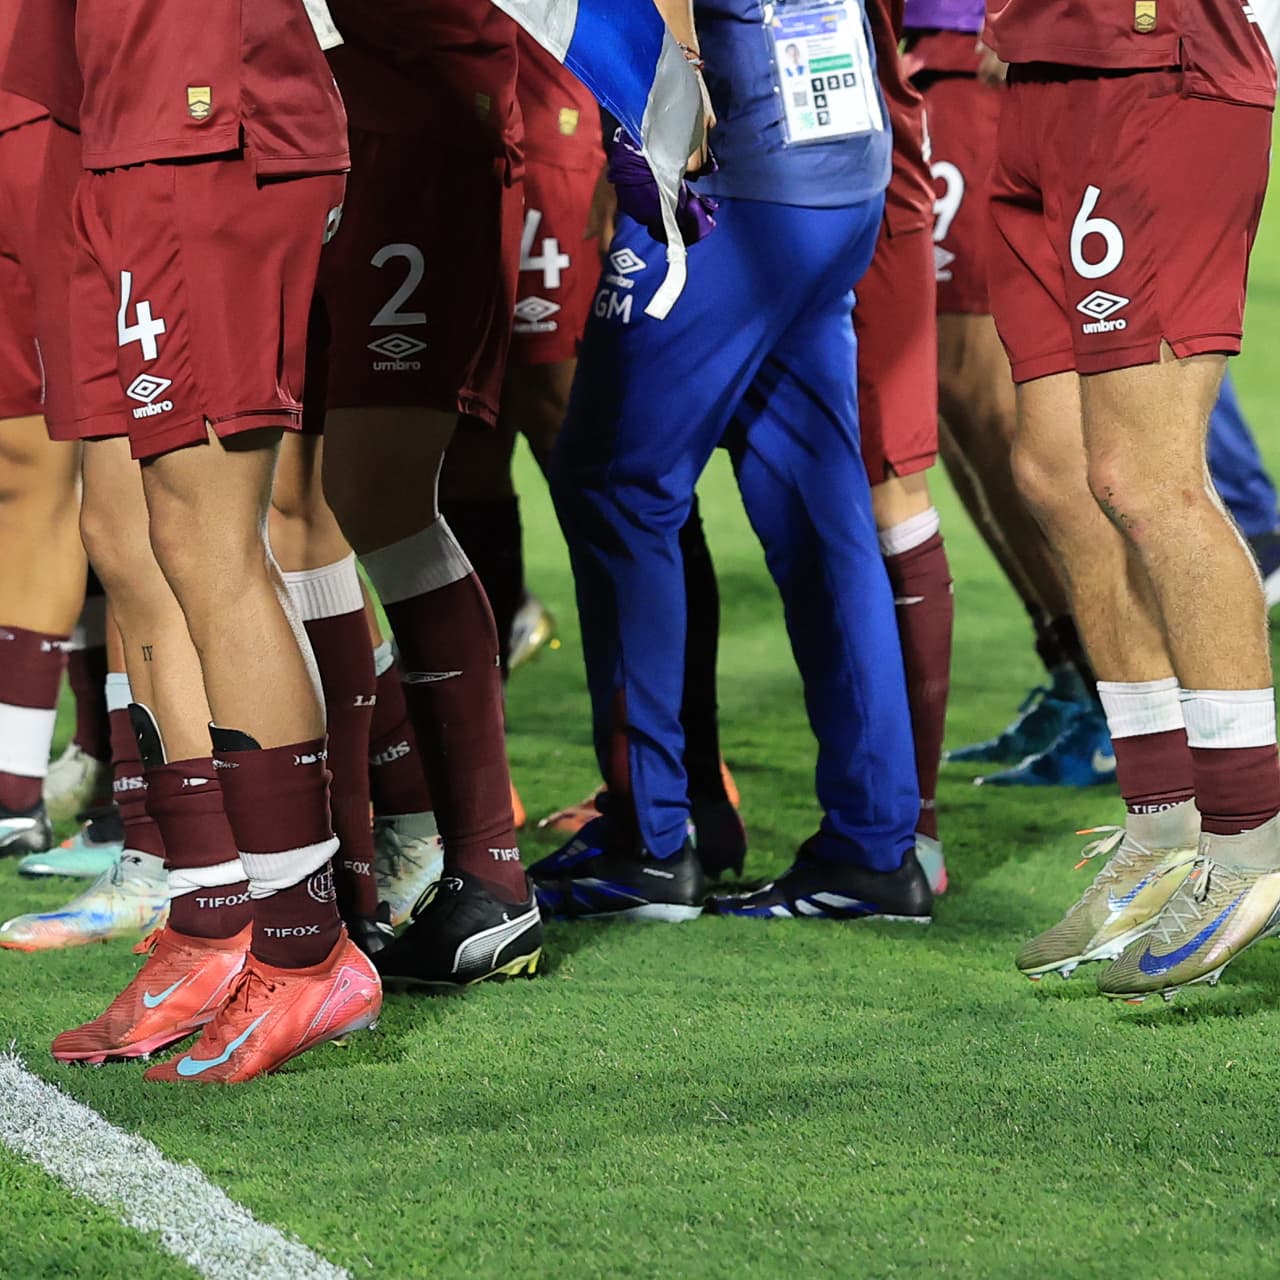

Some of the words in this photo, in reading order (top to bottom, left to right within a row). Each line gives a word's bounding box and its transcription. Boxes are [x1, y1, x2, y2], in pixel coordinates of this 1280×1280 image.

[1070, 184, 1124, 279] 6
[369, 243, 427, 326] 2
[118, 270, 167, 361] 4
[594, 289, 633, 324] GM
[1083, 318, 1127, 334] umbro
[373, 358, 422, 371] umbro
[133, 398, 174, 419] umbro
[488, 847, 521, 862] TIFO
[195, 891, 252, 908] TIFOX
[263, 925, 320, 938] TIFOX
